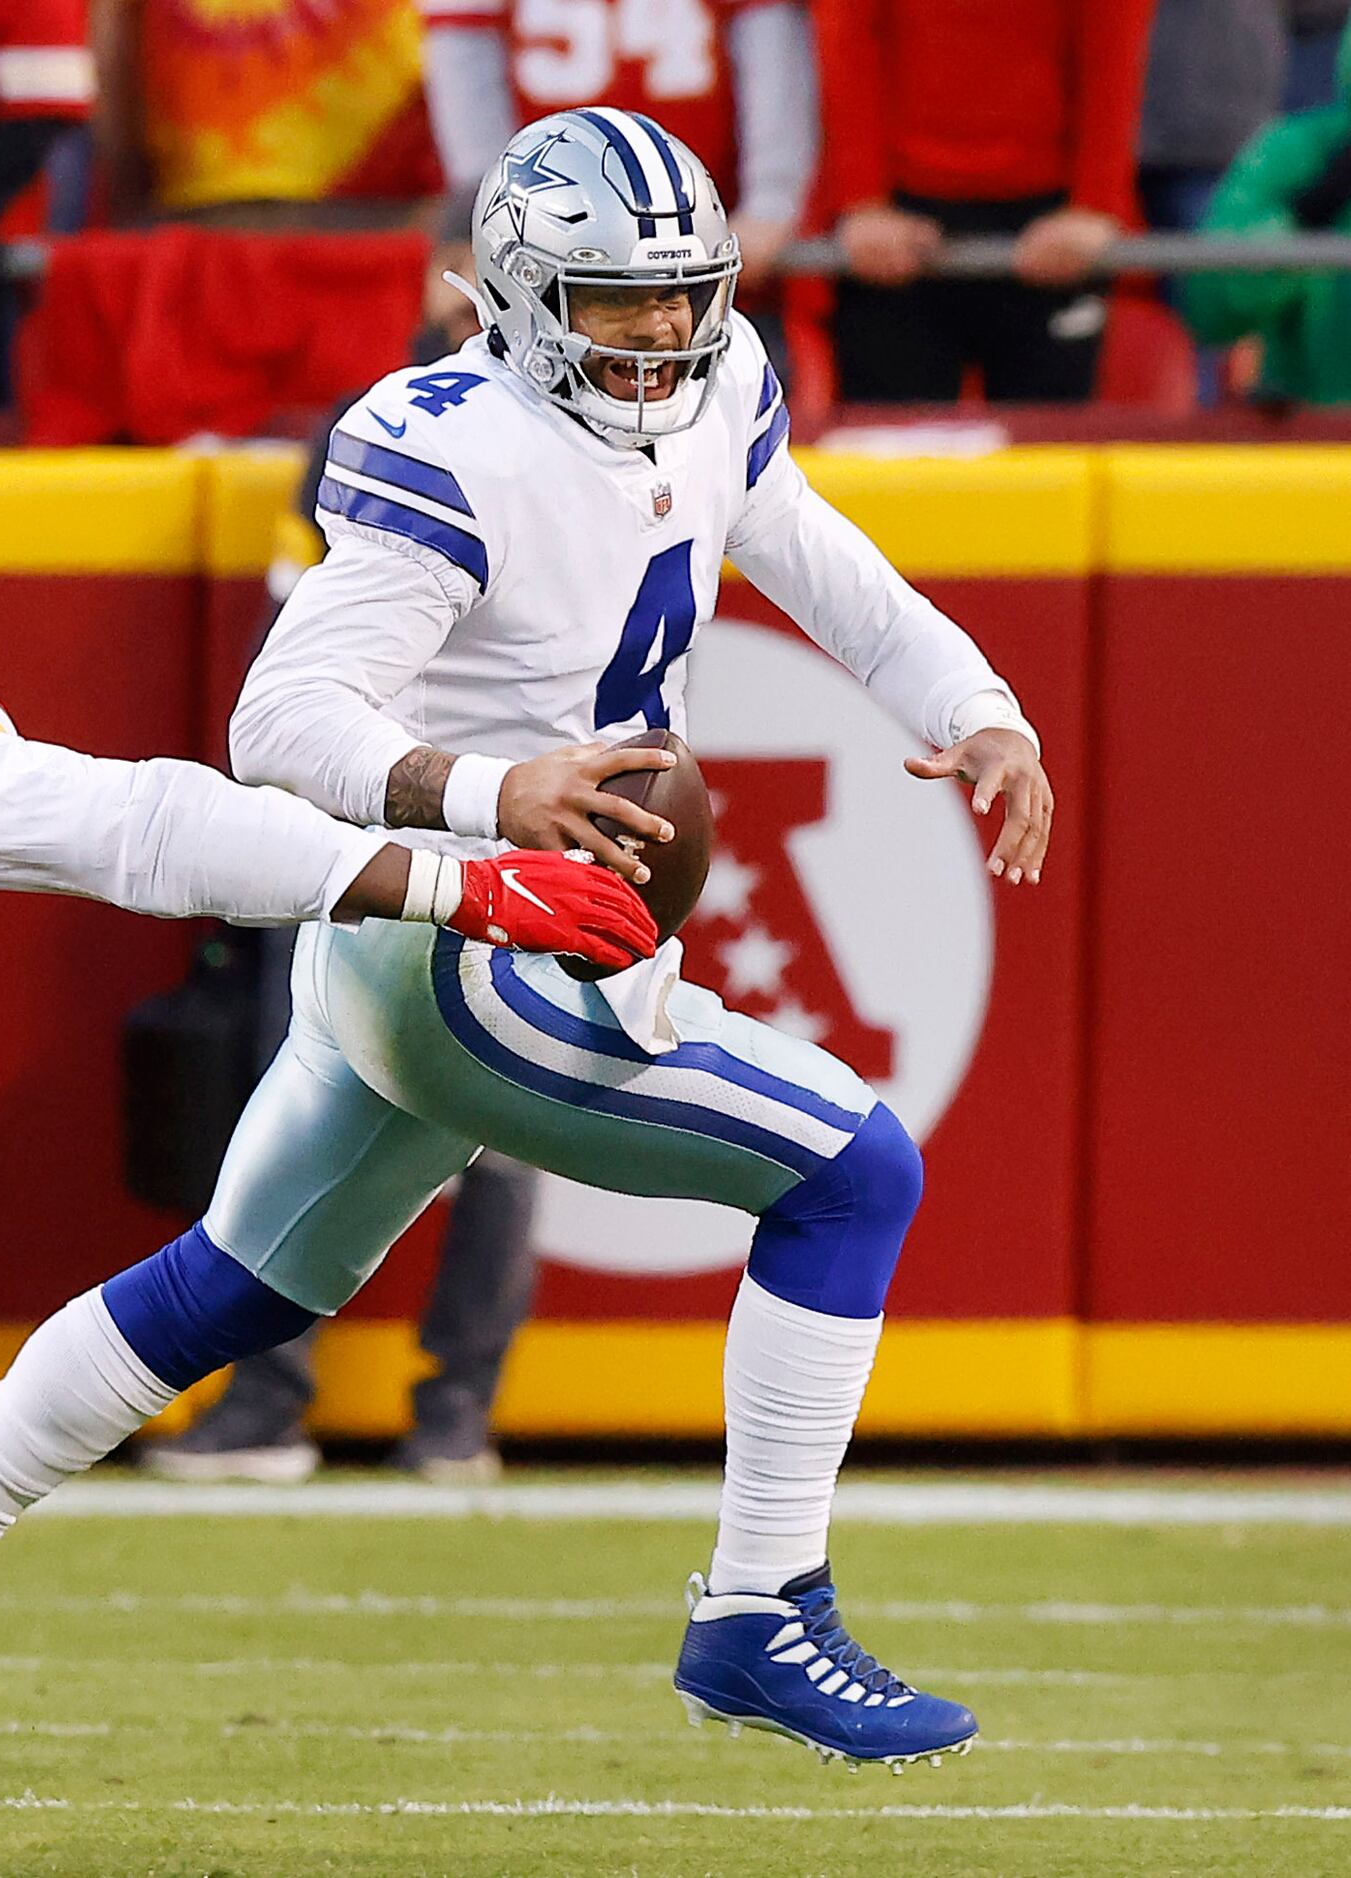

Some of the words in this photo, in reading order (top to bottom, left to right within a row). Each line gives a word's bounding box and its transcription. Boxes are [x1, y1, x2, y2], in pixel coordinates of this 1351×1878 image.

[647, 249, 692, 260] COWBOYS
[406, 372, 490, 417] 4
[594, 538, 696, 730] 4
